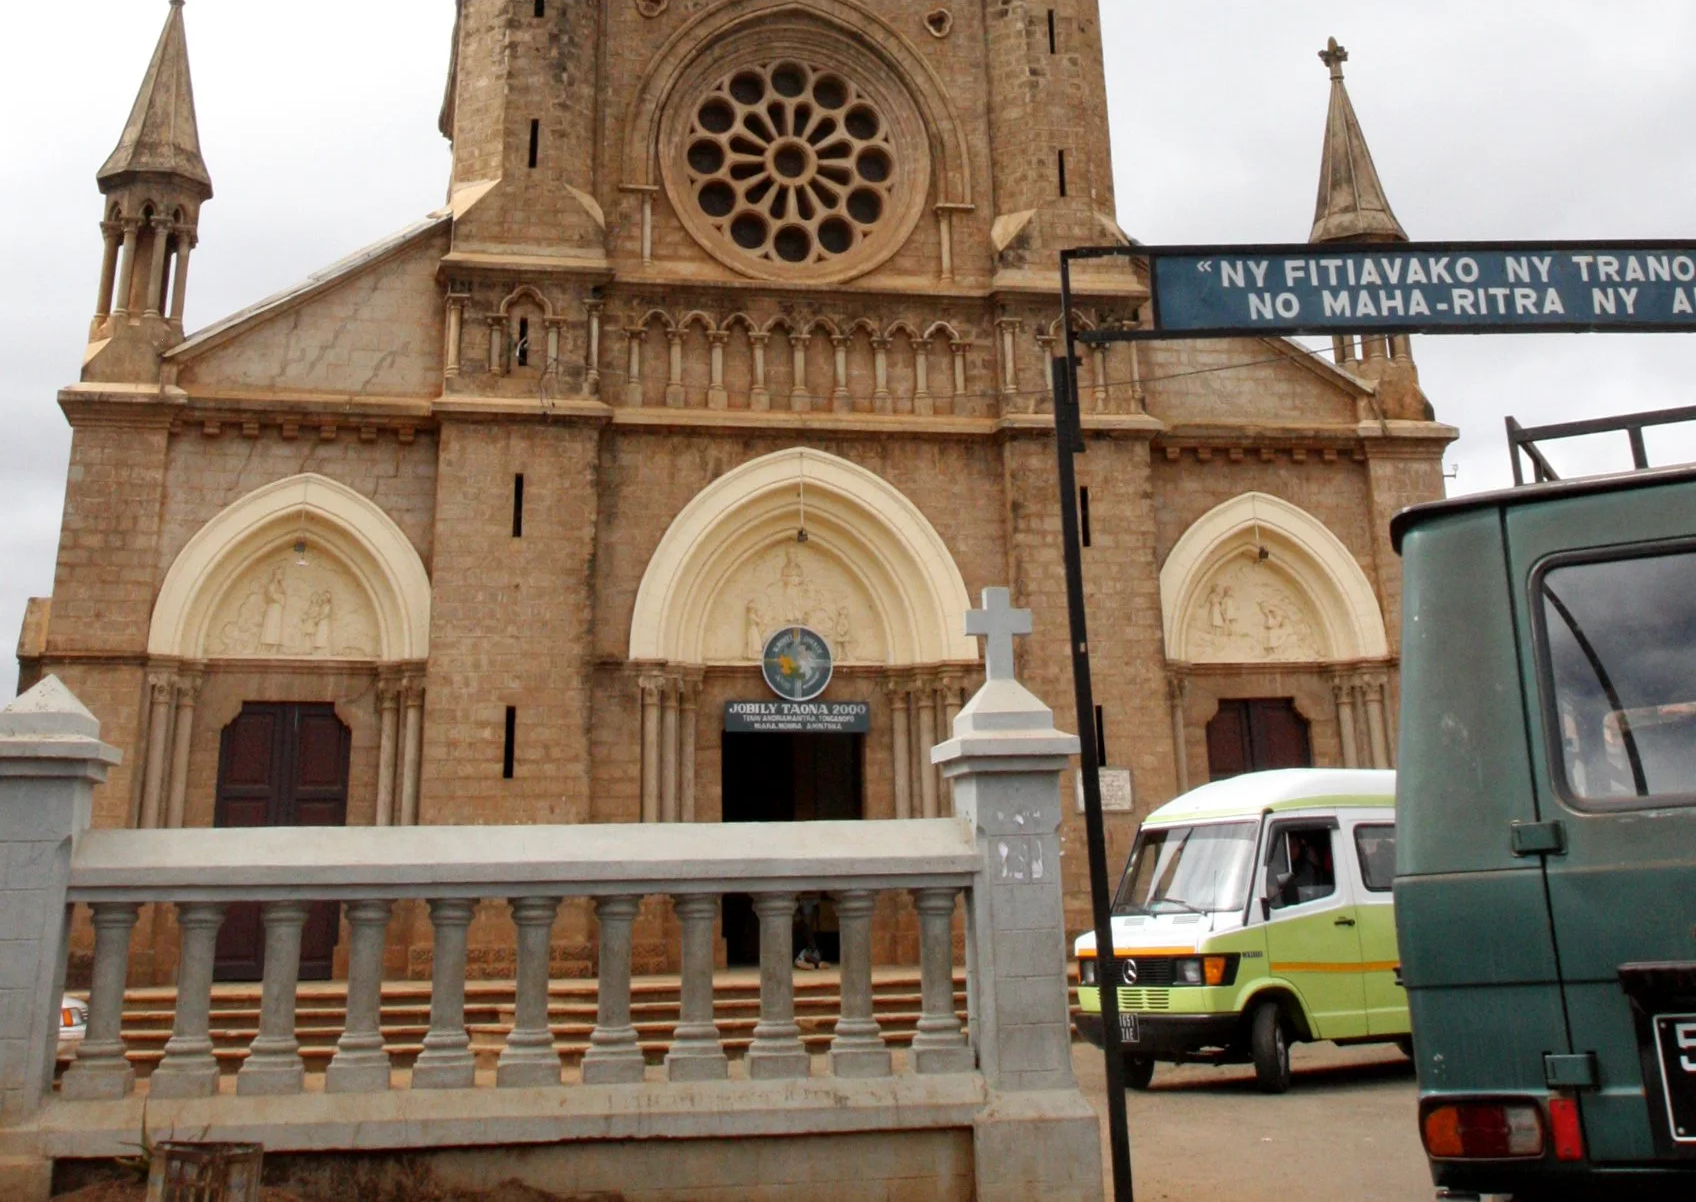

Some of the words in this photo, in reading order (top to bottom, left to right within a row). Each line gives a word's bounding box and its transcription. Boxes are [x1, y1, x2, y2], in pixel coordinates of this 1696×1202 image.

[1284, 256, 1480, 287] FITIAVAKO
[1505, 256, 1552, 283] NY
[1571, 255, 1695, 282] TRANO
[1248, 292, 1300, 320] NO
[1322, 287, 1565, 317] MAHA-RITRA
[1592, 287, 1638, 315] NY
[1672, 287, 1696, 314] A
[729, 703, 777, 714] JOBILY
[781, 703, 828, 715] TAONA
[832, 704, 867, 715] 2000
